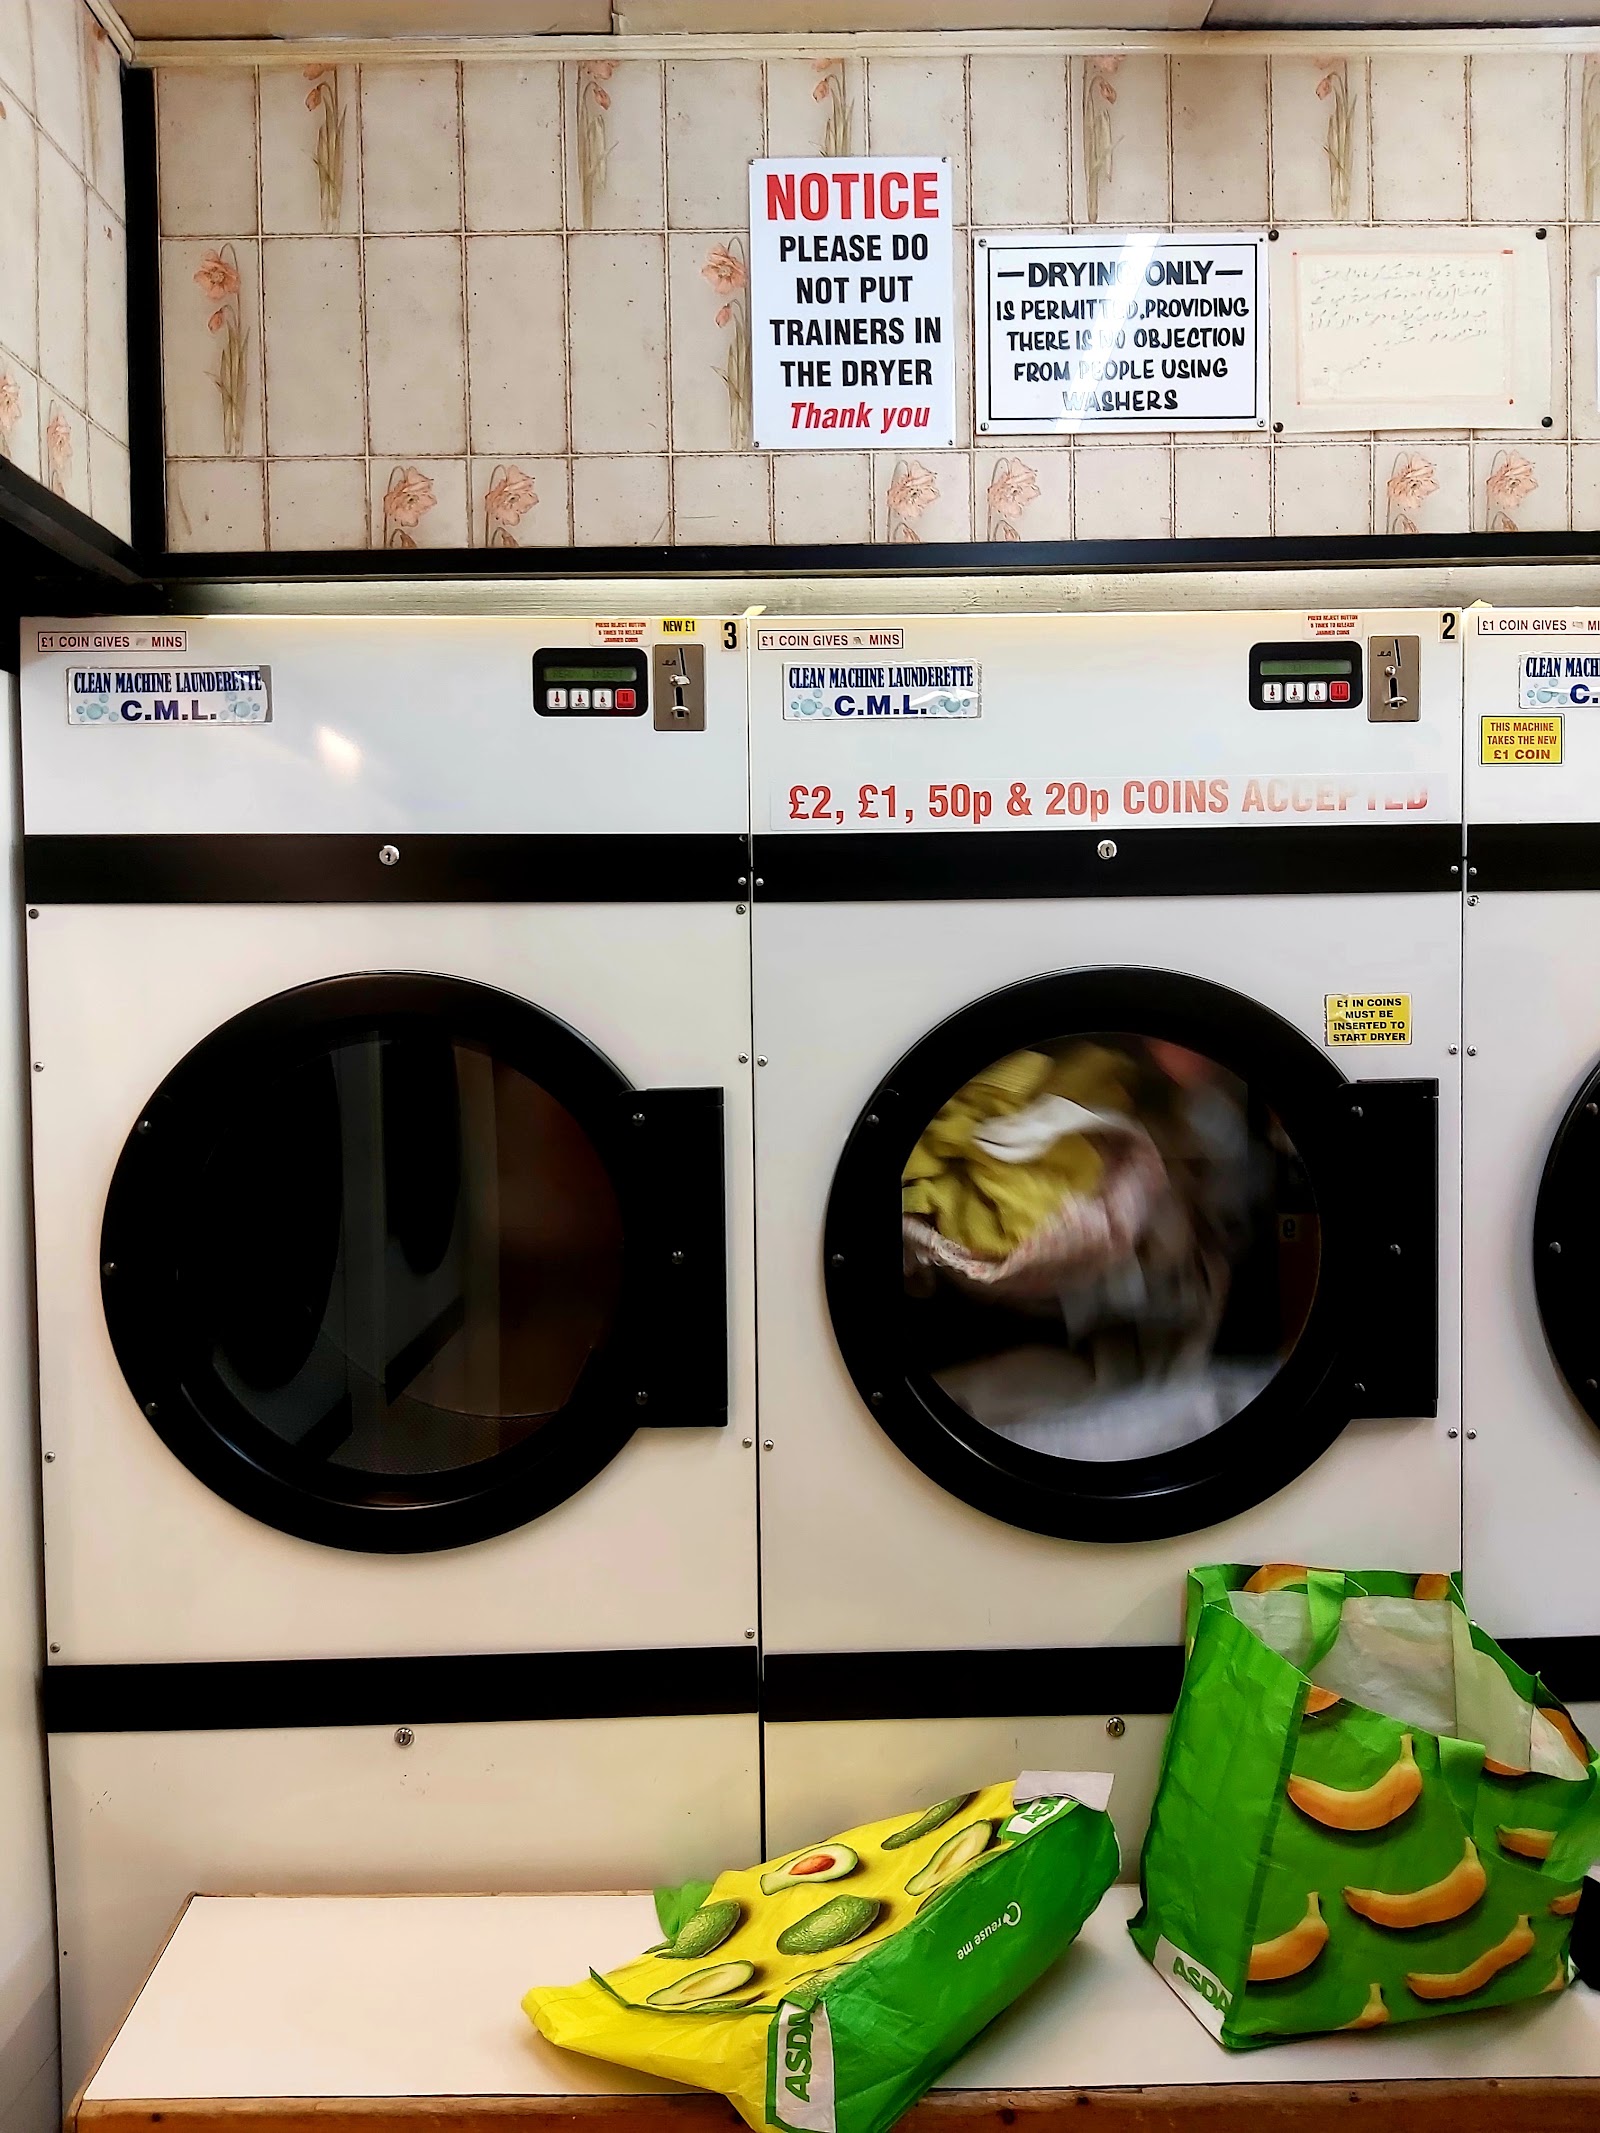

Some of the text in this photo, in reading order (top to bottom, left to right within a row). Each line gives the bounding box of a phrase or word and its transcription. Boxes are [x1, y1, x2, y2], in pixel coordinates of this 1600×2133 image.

[766, 171, 940, 221] NOTICE
[780, 233, 929, 262] PLEASE DO
[796, 275, 914, 304] NOT PUT
[996, 300, 1016, 321] IS
[1146, 297, 1250, 319] PROVIDING
[769, 315, 942, 346] TRAINERS IN
[1006, 327, 1245, 351] THERE IS NO OBJECTION
[780, 359, 933, 387] THE DRYER
[1014, 357, 1229, 382] FROM PEOPLE USING
[1062, 389, 1179, 412] WASHERS
[790, 401, 930, 434] Thank you
[663, 620, 695, 632] NEW £1
[723, 621, 738, 650] 3
[1442, 612, 1455, 640] 2
[1482, 620, 1494, 631] £1
[1499, 619, 1528, 631] COIN
[1532, 619, 1567, 631] GIVES
[41, 637, 55, 648] £1
[59, 636, 90, 648] COIN
[93, 636, 130, 648] GIVES
[151, 636, 183, 648] MINS
[762, 636, 774, 646] £1
[779, 635, 809, 646] COIN
[813, 635, 848, 646] GIVES
[869, 634, 900, 645] MINS
[789, 665, 974, 689] CLEAN MACHINE LAUNDERETTE
[1525, 657, 1562, 678] CLEAN
[74, 670, 263, 694] CLEAN MACHINE LAUNDERETTE
[120, 700, 217, 722] C.M.L.
[834, 695, 927, 717] C.M.L.
[1490, 722, 1554, 732] THIS MACHINE
[1487, 735, 1557, 745] TAKES THE NEW
[1493, 749, 1551, 760] £1 COIN
[789, 784, 844, 825] £2,
[858, 784, 914, 824] £1,
[928, 783, 992, 825] 50p
[1006, 782, 1032, 817] &
[1045, 781, 1109, 822] 20p
[1123, 779, 1229, 815] COINS
[1337, 998, 1402, 1008] £1 IN COINS
[1345, 1010, 1394, 1019] MUST BE
[1333, 1021, 1405, 1030] INSERTED TO
[1333, 1032, 1406, 1042] START DRYER
[956, 1917, 1002, 1960] reuse me
[1172, 1956, 1231, 2014] ASDA
[785, 2010, 814, 2103] ASDA
